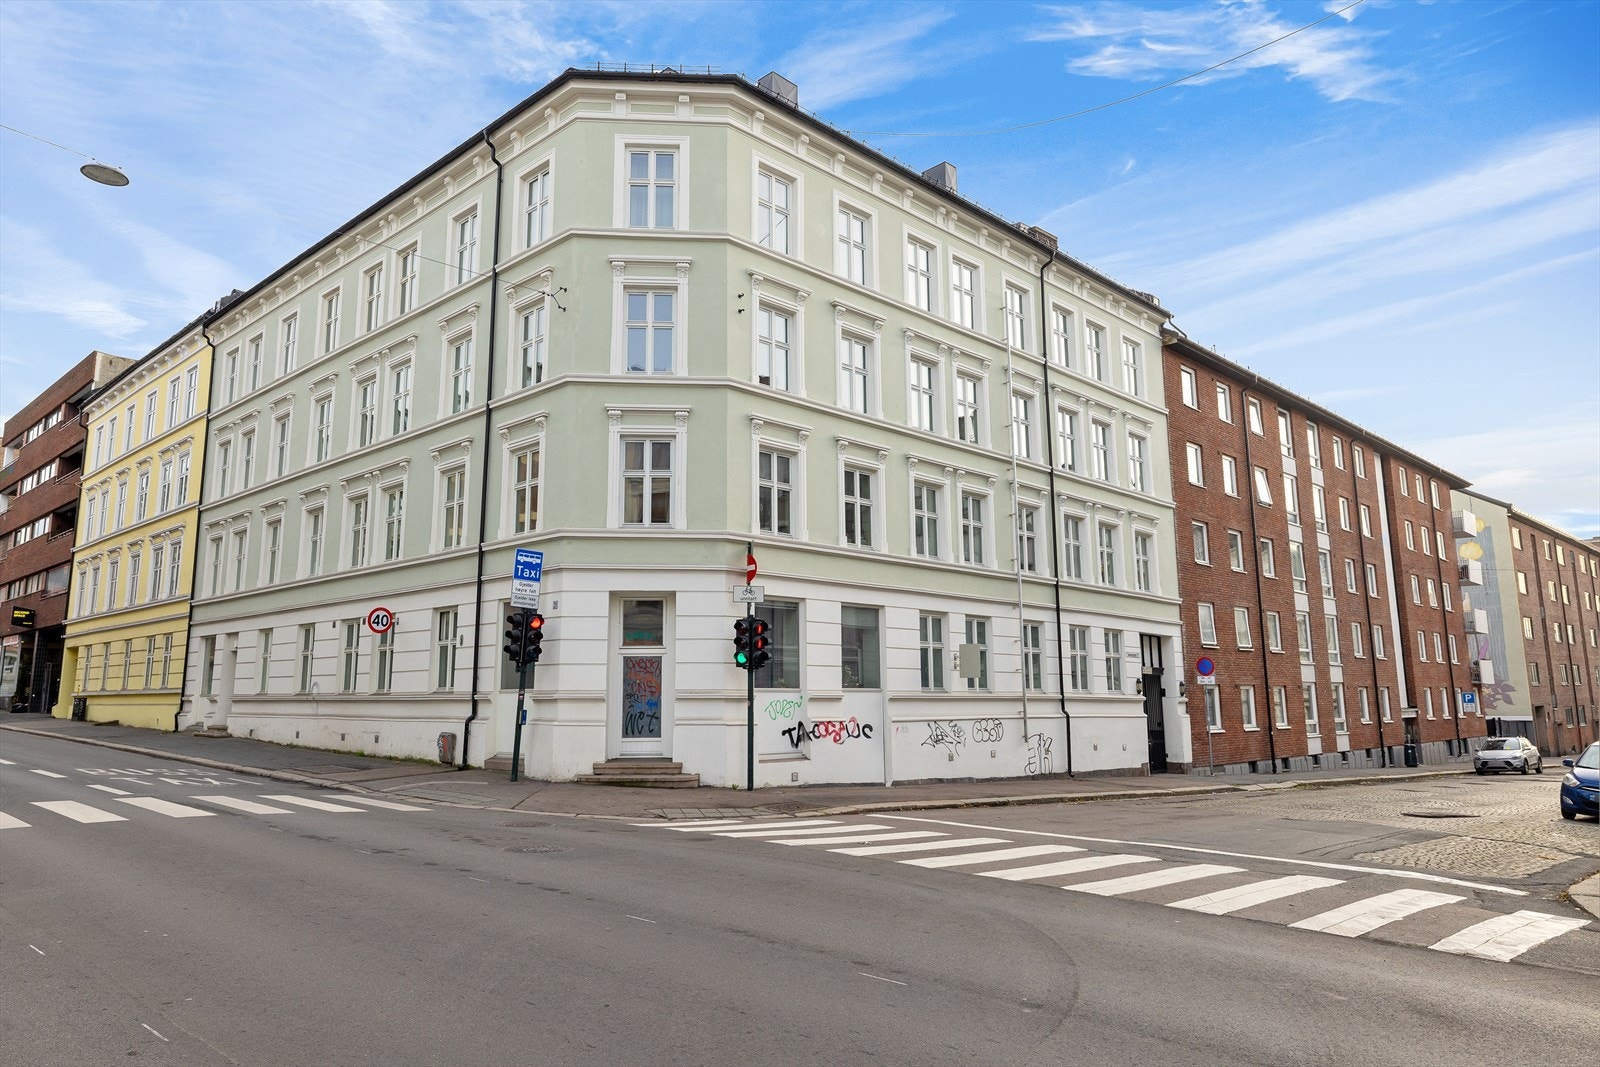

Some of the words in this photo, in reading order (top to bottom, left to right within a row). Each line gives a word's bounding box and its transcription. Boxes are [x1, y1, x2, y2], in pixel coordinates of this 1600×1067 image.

[517, 565, 540, 579] Taxi
[372, 614, 389, 627] 40
[110, 777, 263, 785] TAXI
